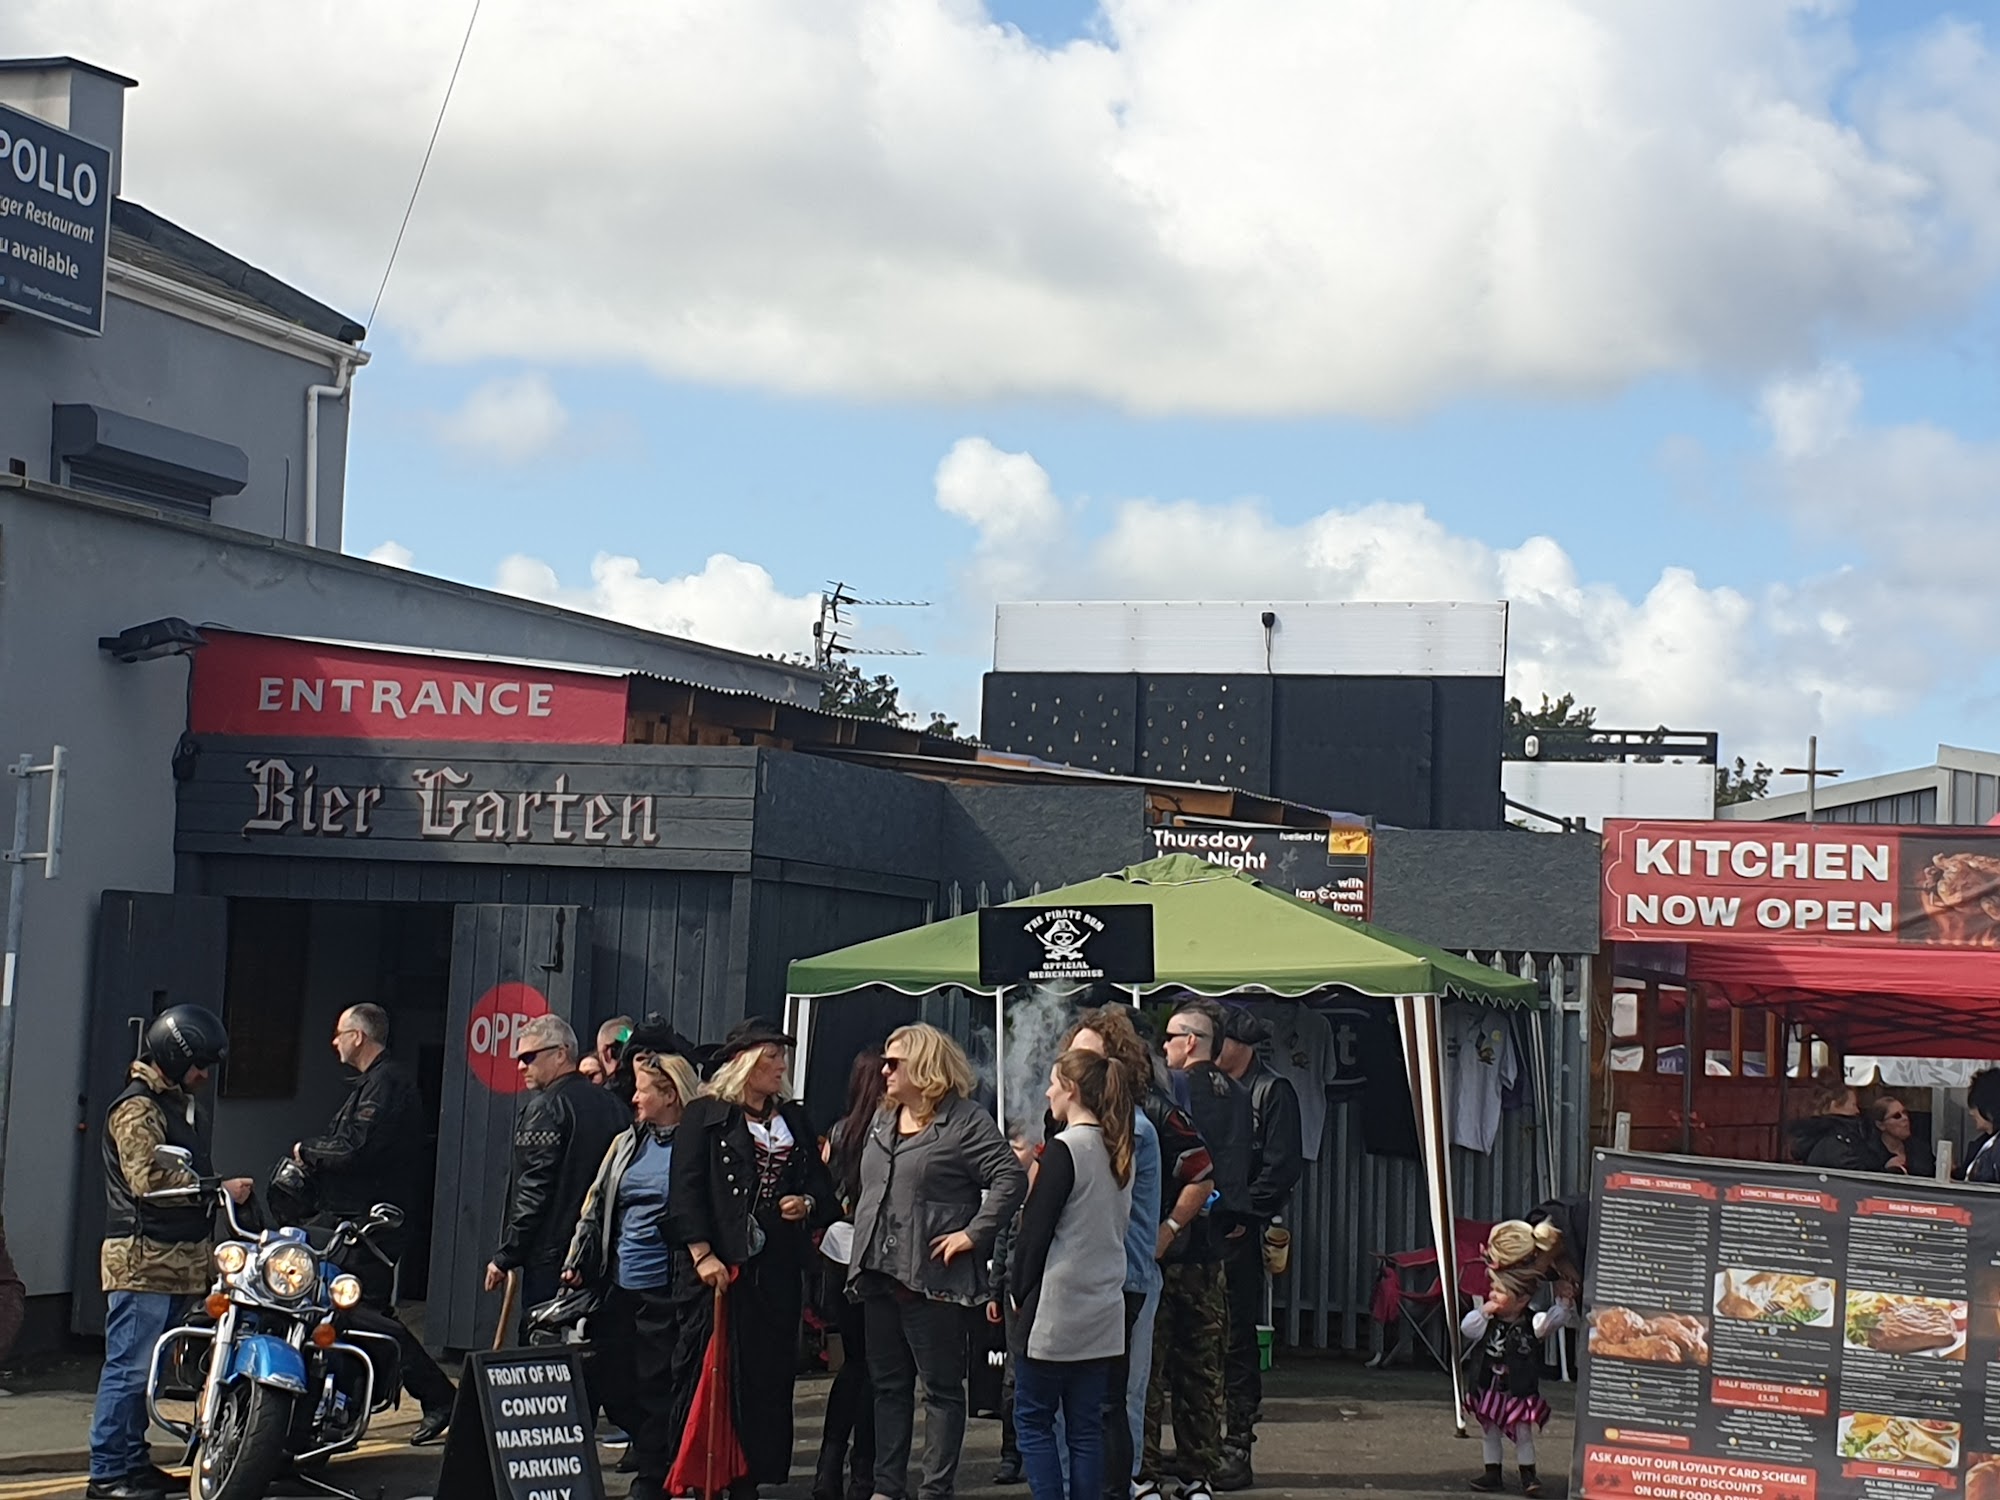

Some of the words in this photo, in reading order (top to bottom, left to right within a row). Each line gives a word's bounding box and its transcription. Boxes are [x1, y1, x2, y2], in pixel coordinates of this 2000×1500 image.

[25, 201, 94, 243] Restaurant
[12, 242, 79, 279] available
[257, 677, 554, 719] ENTRANCE
[241, 758, 385, 840] Bier
[413, 766, 660, 847] Garten
[1153, 830, 1253, 852] Thursday
[1314, 832, 1327, 843] by
[1207, 851, 1267, 871] Night
[1634, 838, 1890, 881] KITCHEN
[1295, 888, 1316, 899] Ian
[1319, 889, 1364, 900] Cowell
[1337, 878, 1364, 889] with
[1333, 901, 1363, 912] from
[1626, 893, 1741, 927] NOW
[1756, 898, 1893, 932] OPEN
[1023, 915, 1045, 933] THE
[1045, 909, 1082, 922] PIRATE
[1083, 914, 1105, 932] RUN
[1028, 969, 1104, 979] MERCHANDISE
[1042, 961, 1089, 970] OFFICIAL
[470, 1012, 528, 1059] OPE
[487, 1367, 527, 1386] FRONT
[529, 1365, 544, 1382] OF
[547, 1364, 571, 1382] PUB
[501, 1395, 568, 1416] CONVOY
[495, 1425, 584, 1449] MARSHALS
[508, 1456, 582, 1480] PARKING
[1589, 1451, 1612, 1463] ASK
[1614, 1454, 1653, 1467] ABOUT
[1654, 1458, 1678, 1469] OUR
[1680, 1461, 1727, 1476] LOYALTY
[1728, 1467, 1760, 1479] CARD
[1761, 1470, 1808, 1485] SCHEME
[1631, 1470, 1660, 1483] WITH
[1663, 1474, 1698, 1487] GREAT
[1700, 1477, 1763, 1494] DISCOUNTS
[1634, 1485, 1651, 1497] ON
[1653, 1487, 1677, 1499] OUR
[1679, 1490, 1712, 1500] FOOD
